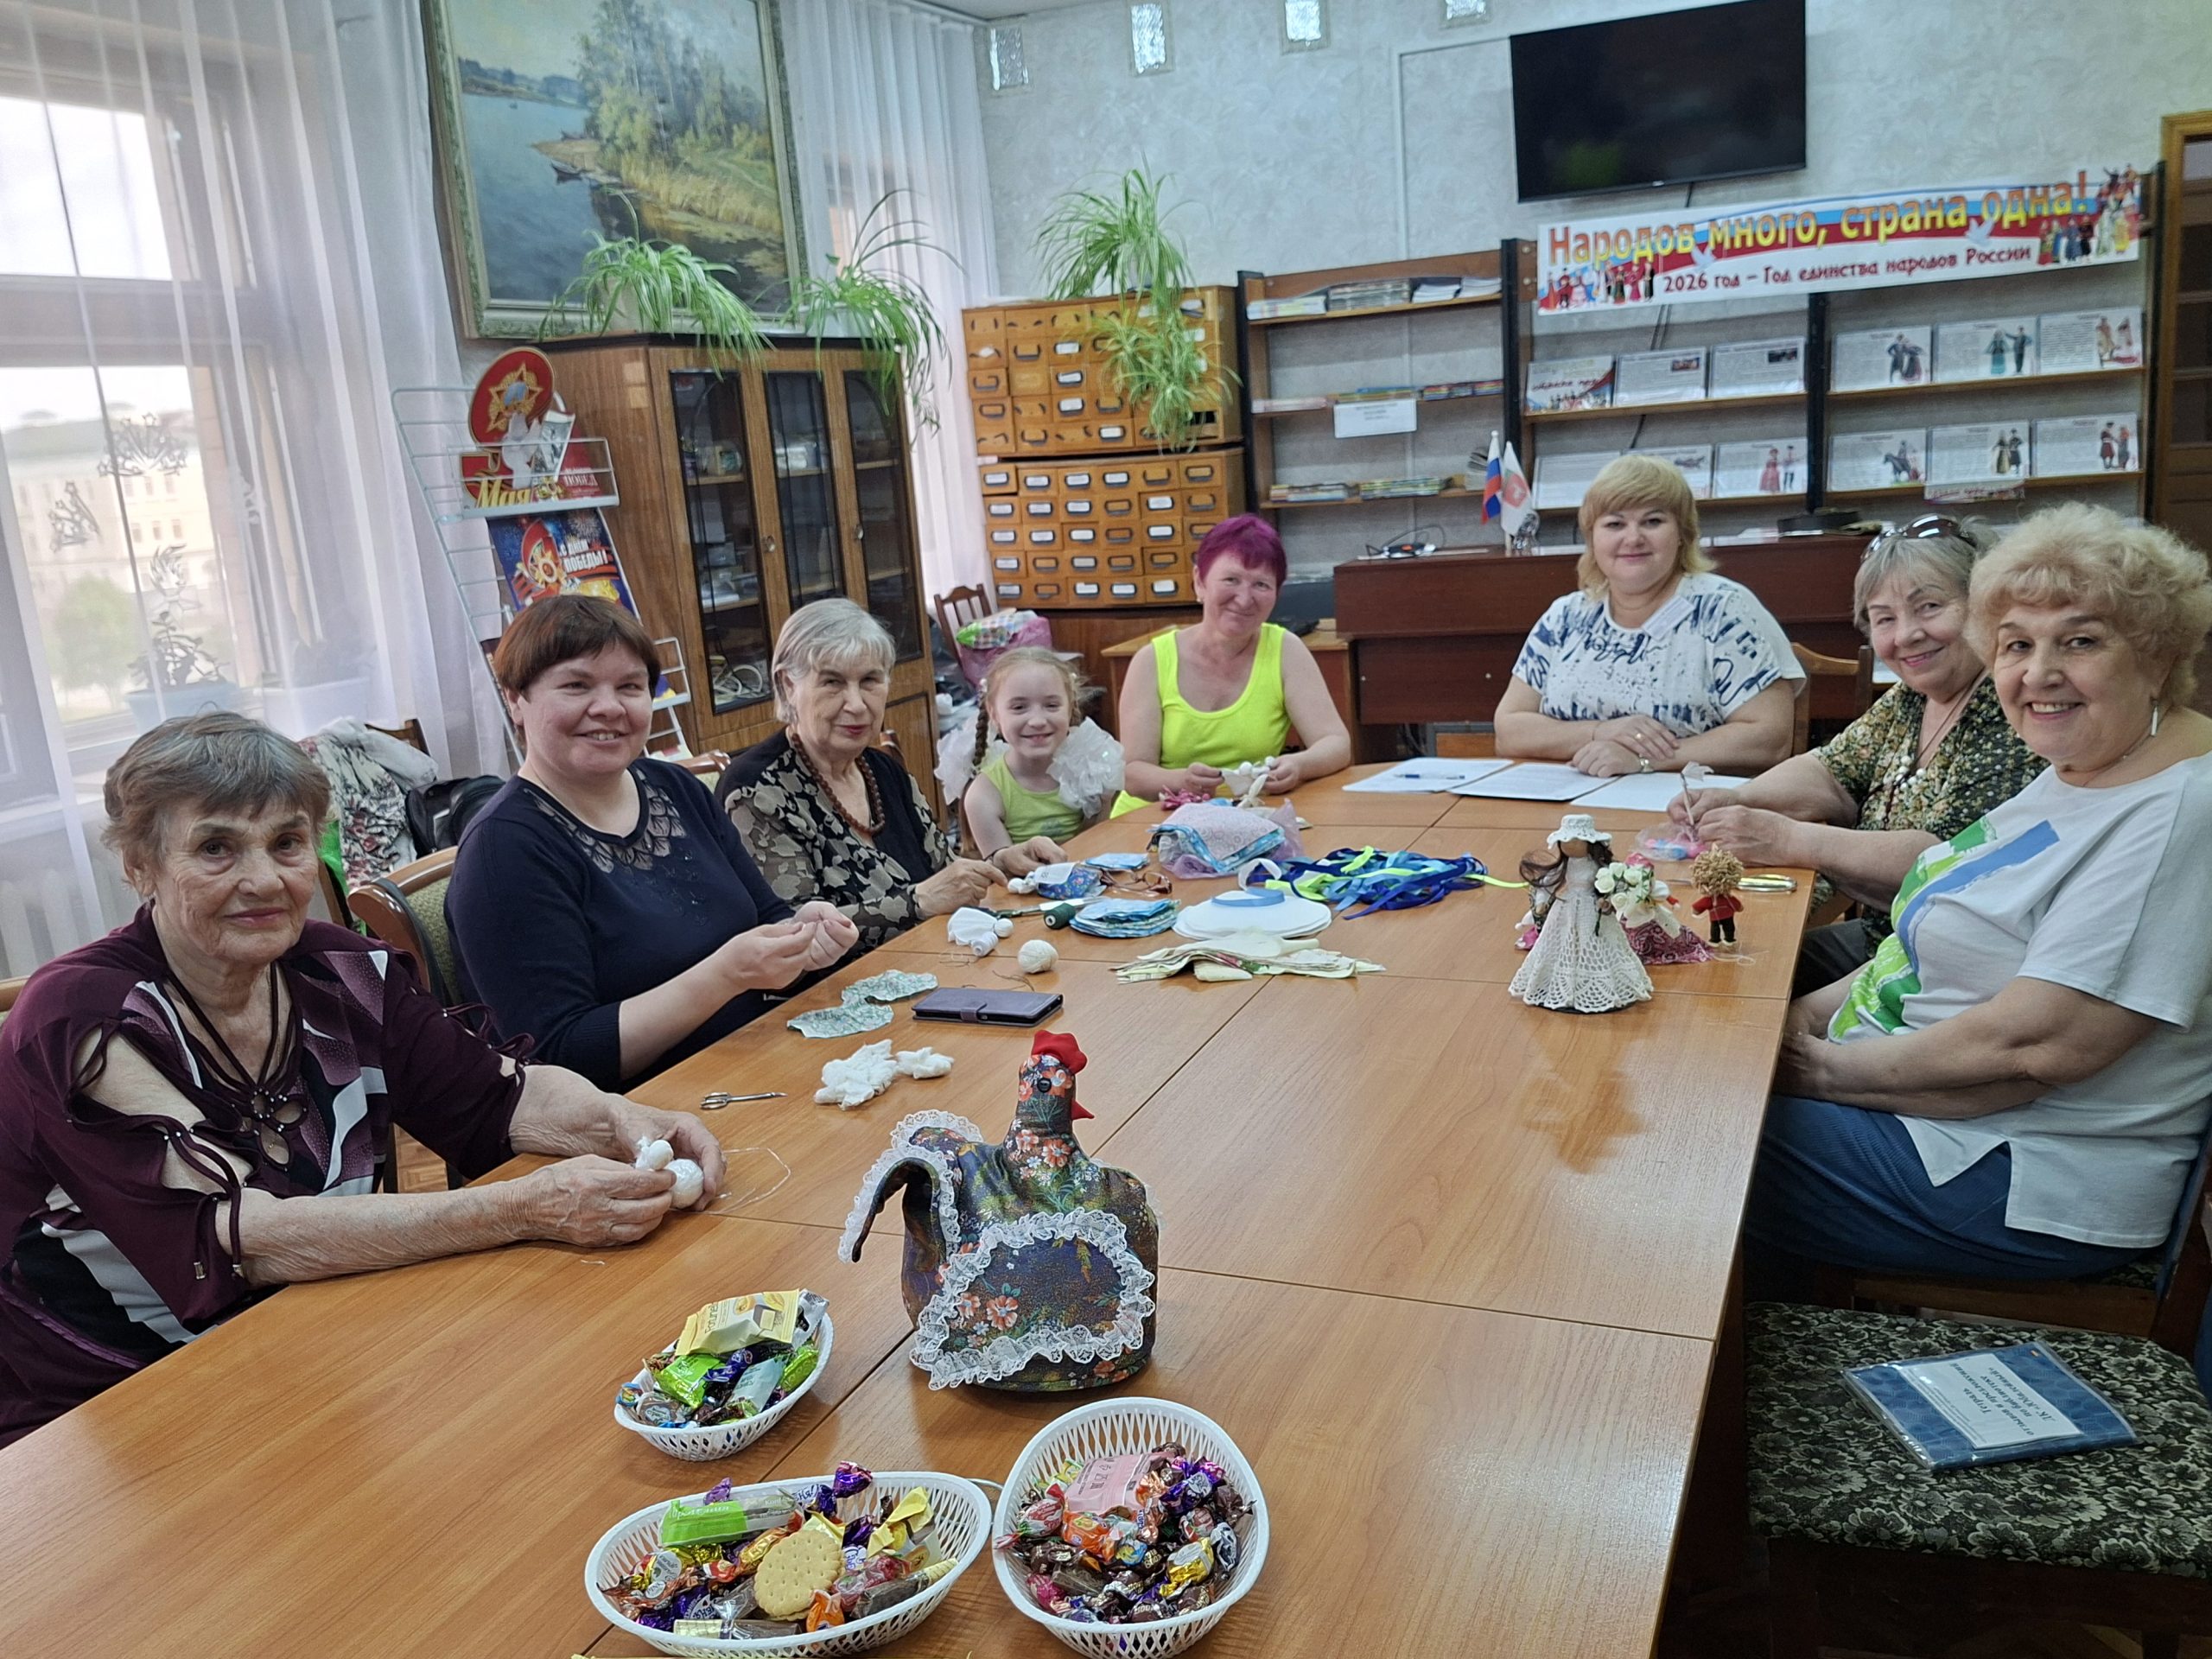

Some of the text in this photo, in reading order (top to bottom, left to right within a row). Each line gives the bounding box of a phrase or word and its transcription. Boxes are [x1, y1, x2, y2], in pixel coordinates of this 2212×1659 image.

[1549, 170, 2088, 267] Народов много, страна одна!
[1663, 273, 1707, 292] 2026
[1715, 272, 1740, 291] год
[1764, 265, 1793, 286] Год
[1798, 261, 1878, 282] единства
[1885, 251, 1957, 277] народов
[1965, 246, 2031, 266] России
[475, 477, 531, 508] Мая
[1949, 1363, 1999, 1402] предложений
[1962, 1387, 1992, 1414] Тетрадь
[1979, 1376, 2032, 1418] по библиотеке
[1999, 1408, 2034, 1435] отзывов
